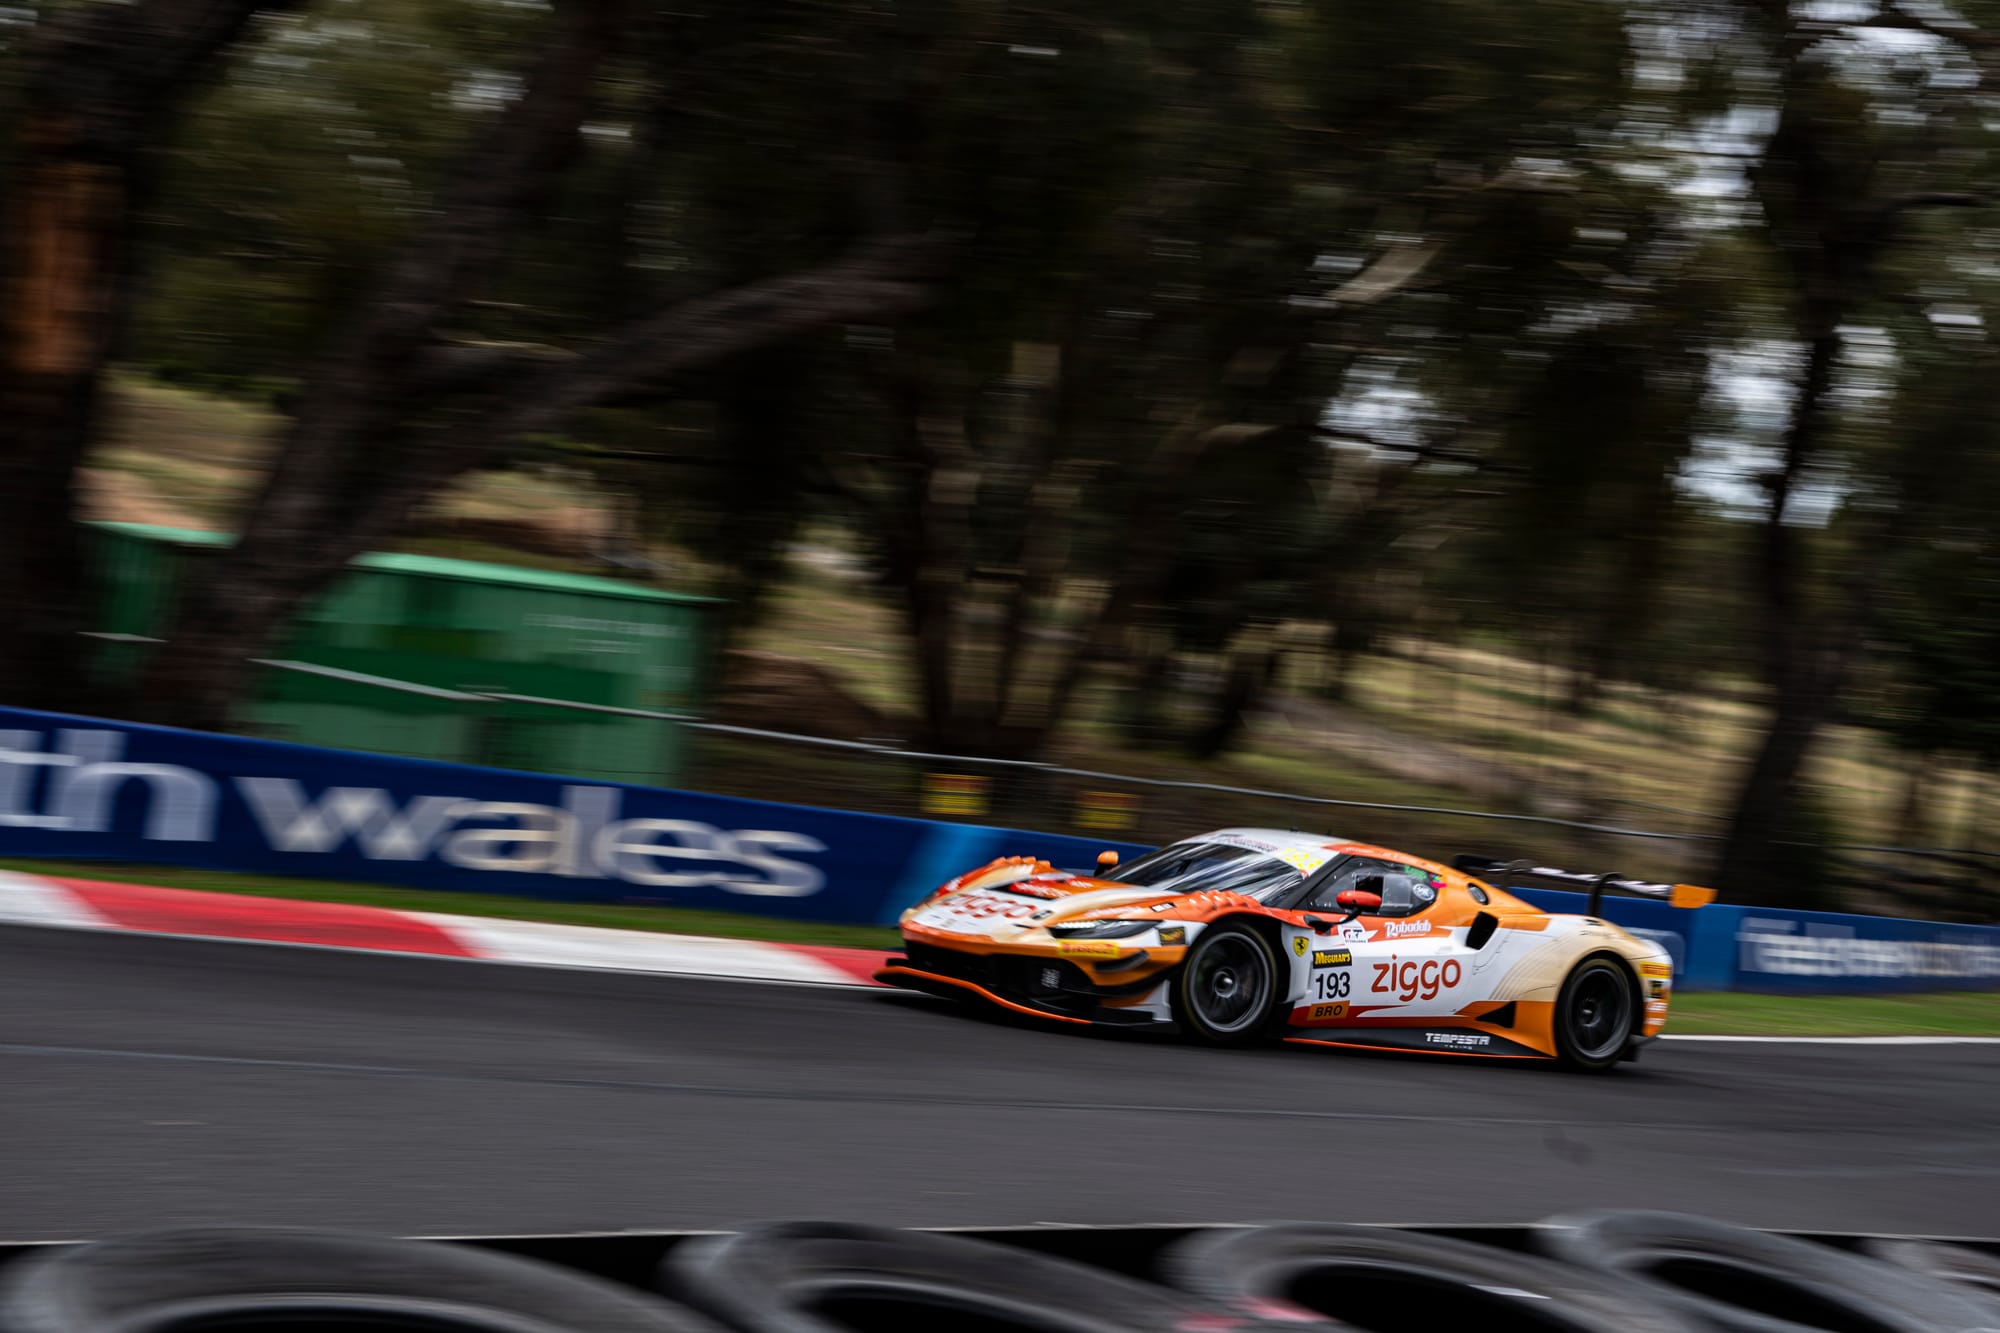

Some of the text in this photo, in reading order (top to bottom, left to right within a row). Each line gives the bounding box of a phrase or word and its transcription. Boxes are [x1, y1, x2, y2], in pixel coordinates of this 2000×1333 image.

[231, 776, 828, 896] wales
[1315, 972, 1350, 999] 193
[1371, 954, 1461, 1002] ziggo
[1315, 1005, 1342, 1017] BRO
[1425, 1032, 1490, 1045] TEMPESTA
